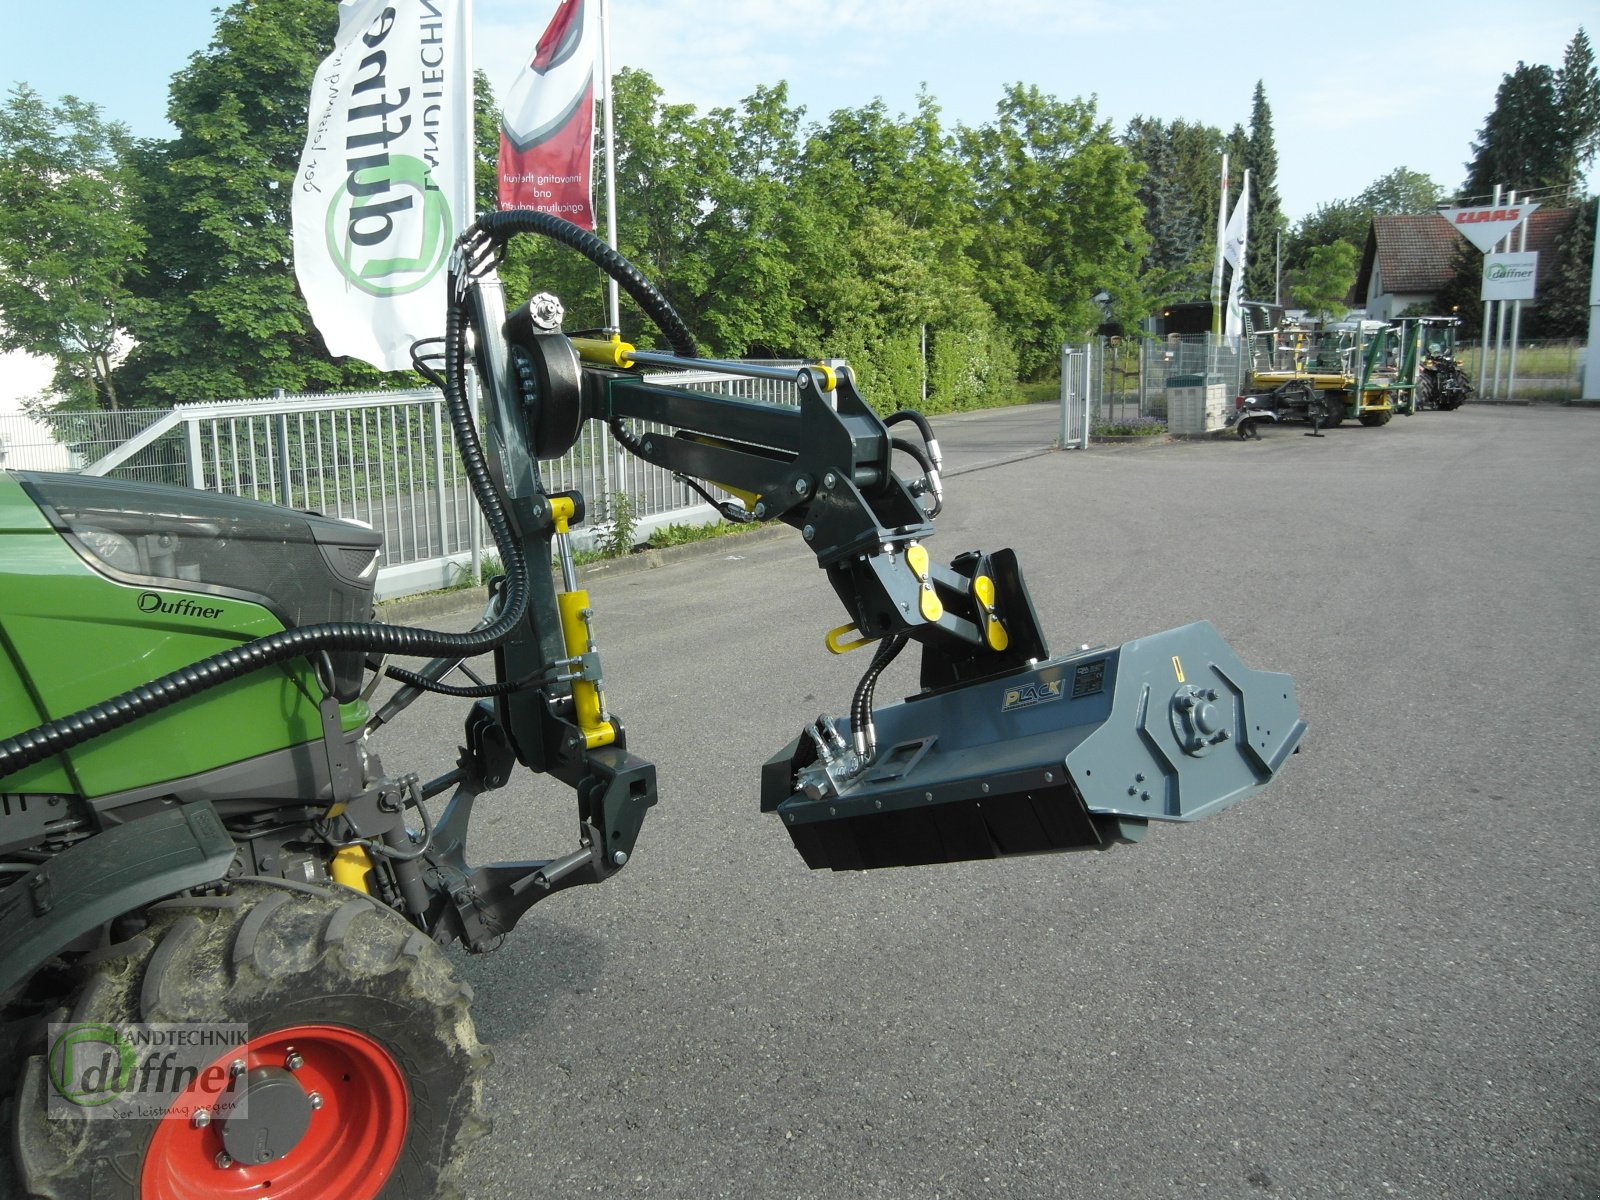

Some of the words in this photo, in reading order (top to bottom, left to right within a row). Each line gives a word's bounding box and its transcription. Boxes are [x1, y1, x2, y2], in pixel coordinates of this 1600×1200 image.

[1455, 209, 1521, 224] CLAAS
[1492, 268, 1534, 279] duffner
[137, 591, 224, 619] Duffner
[1006, 681, 1062, 706] PLACK
